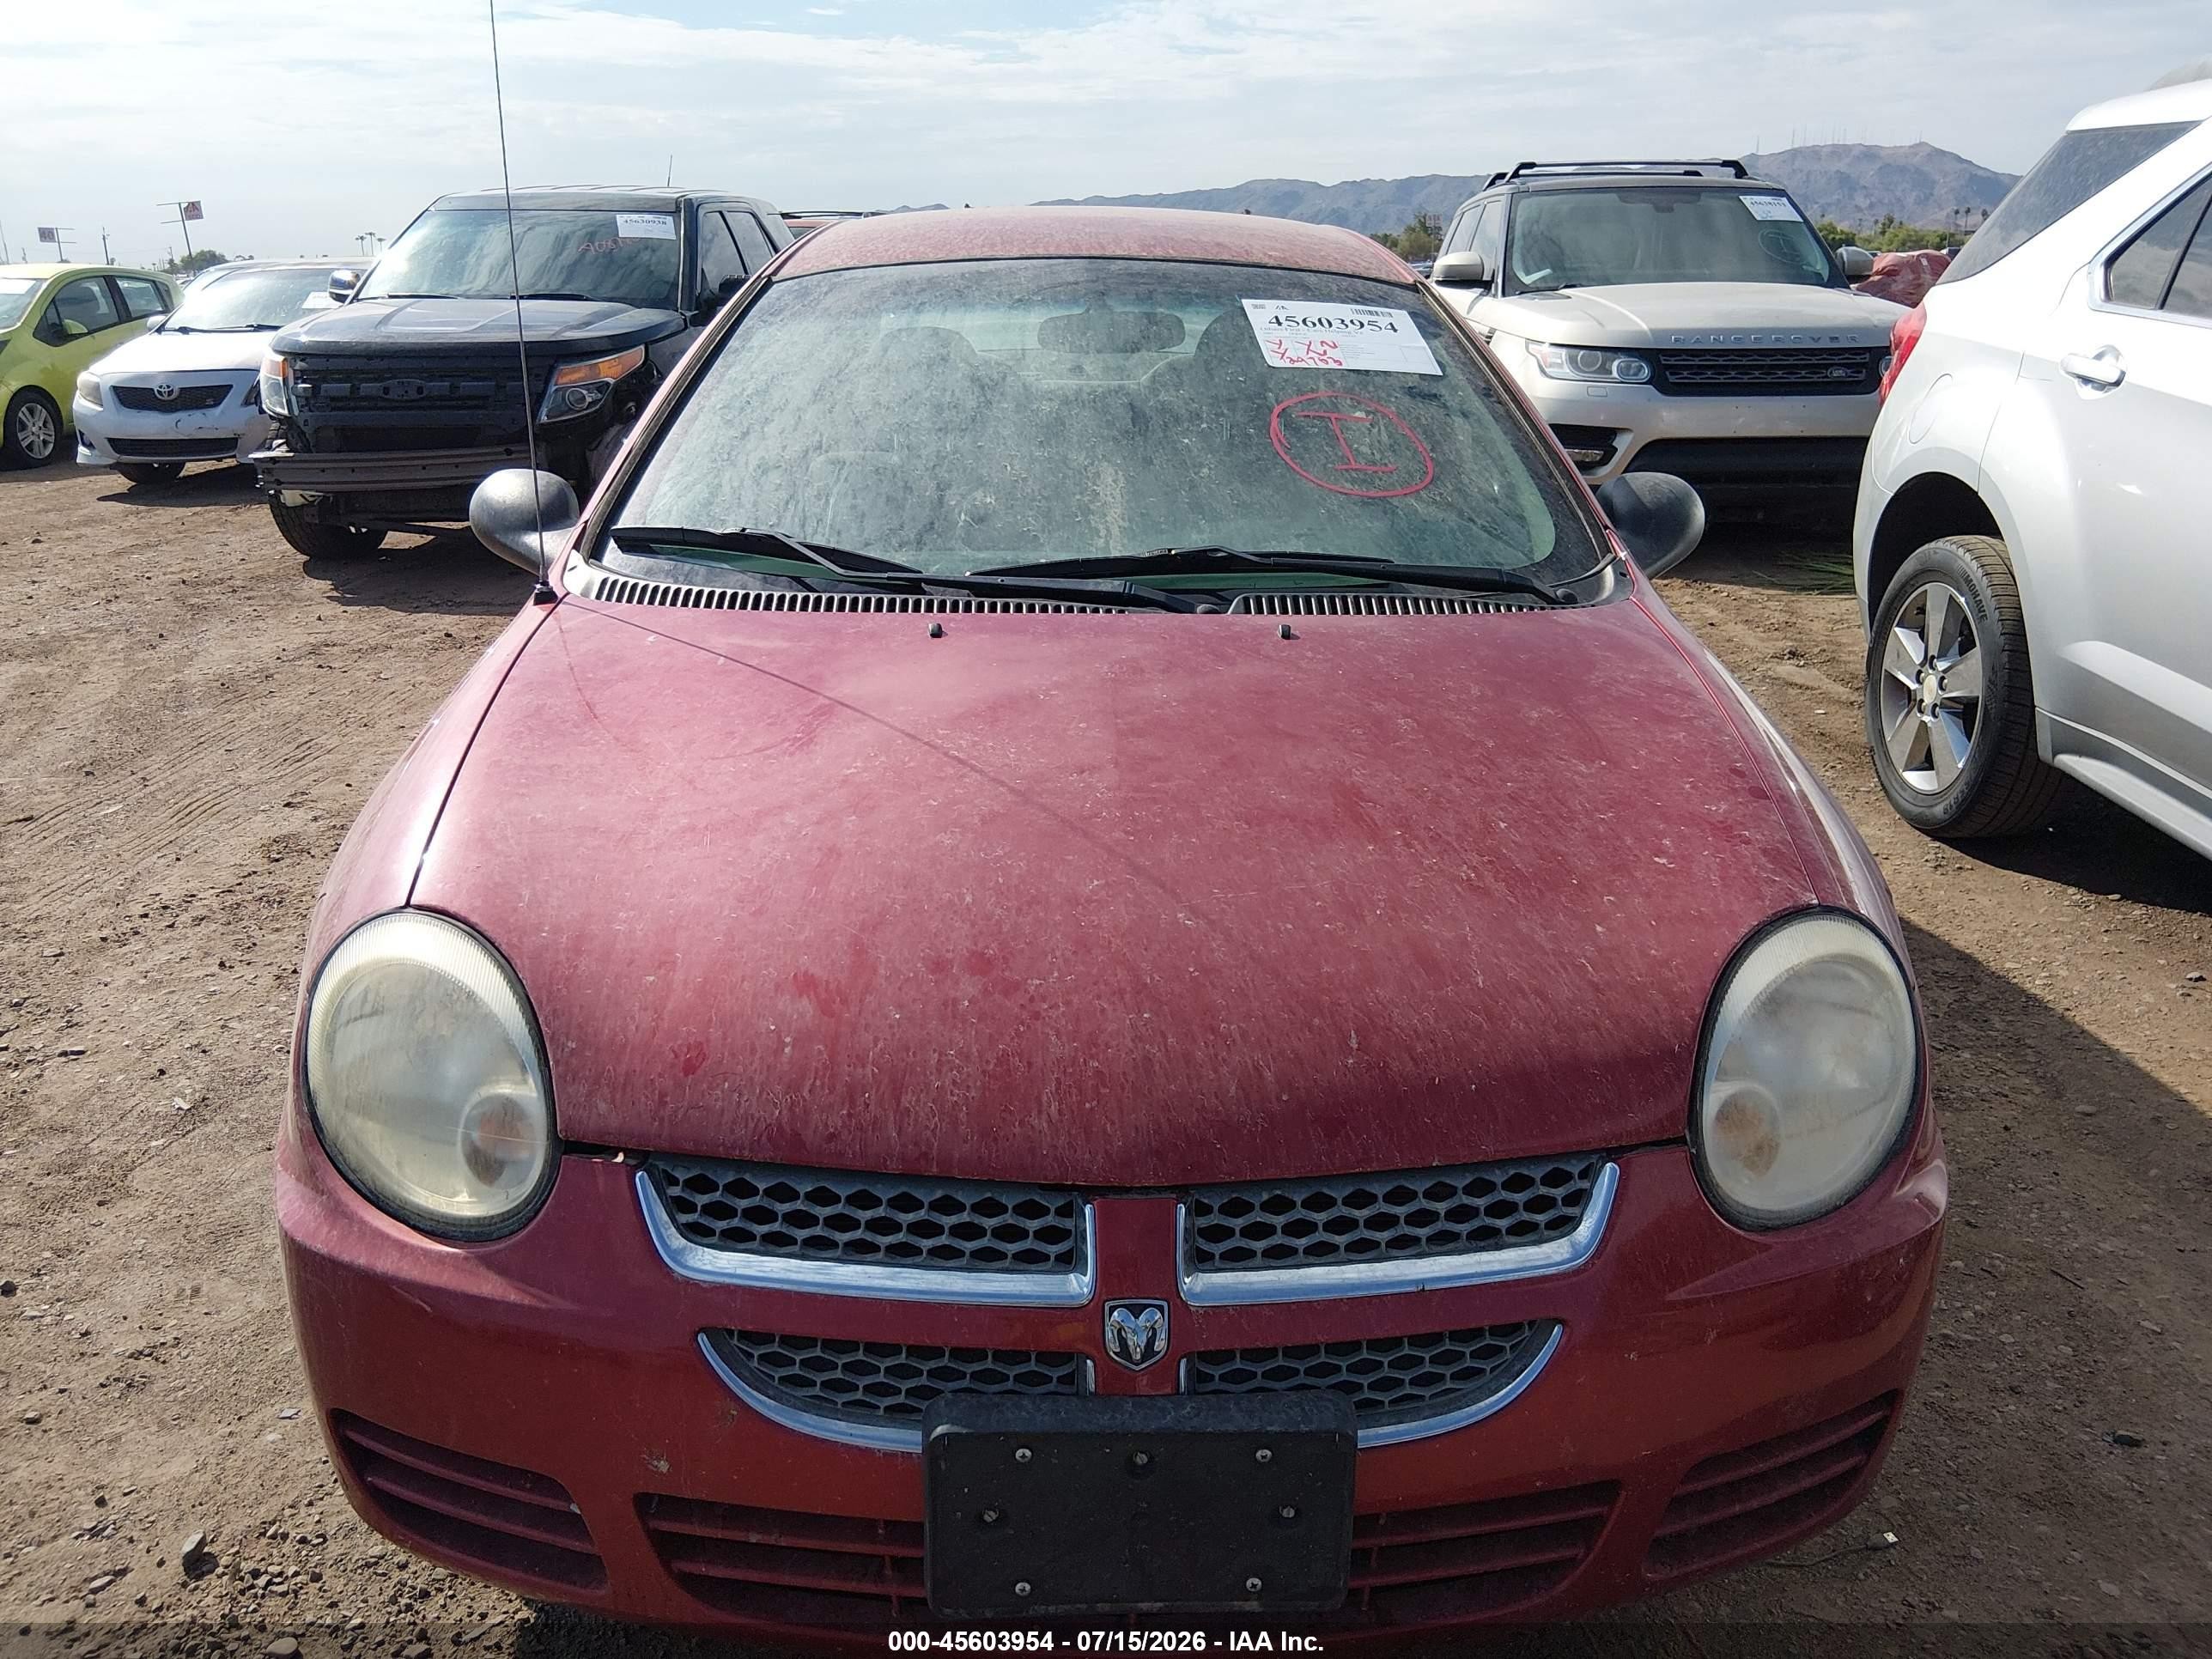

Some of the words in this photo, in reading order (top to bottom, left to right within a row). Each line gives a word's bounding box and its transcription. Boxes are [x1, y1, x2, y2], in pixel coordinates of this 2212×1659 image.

[1268, 314, 1399, 333] 45603954
[1671, 335, 1764, 344] RANGE
[1771, 334, 1860, 344] ROVER
[1963, 571, 1989, 623] MOHAVE
